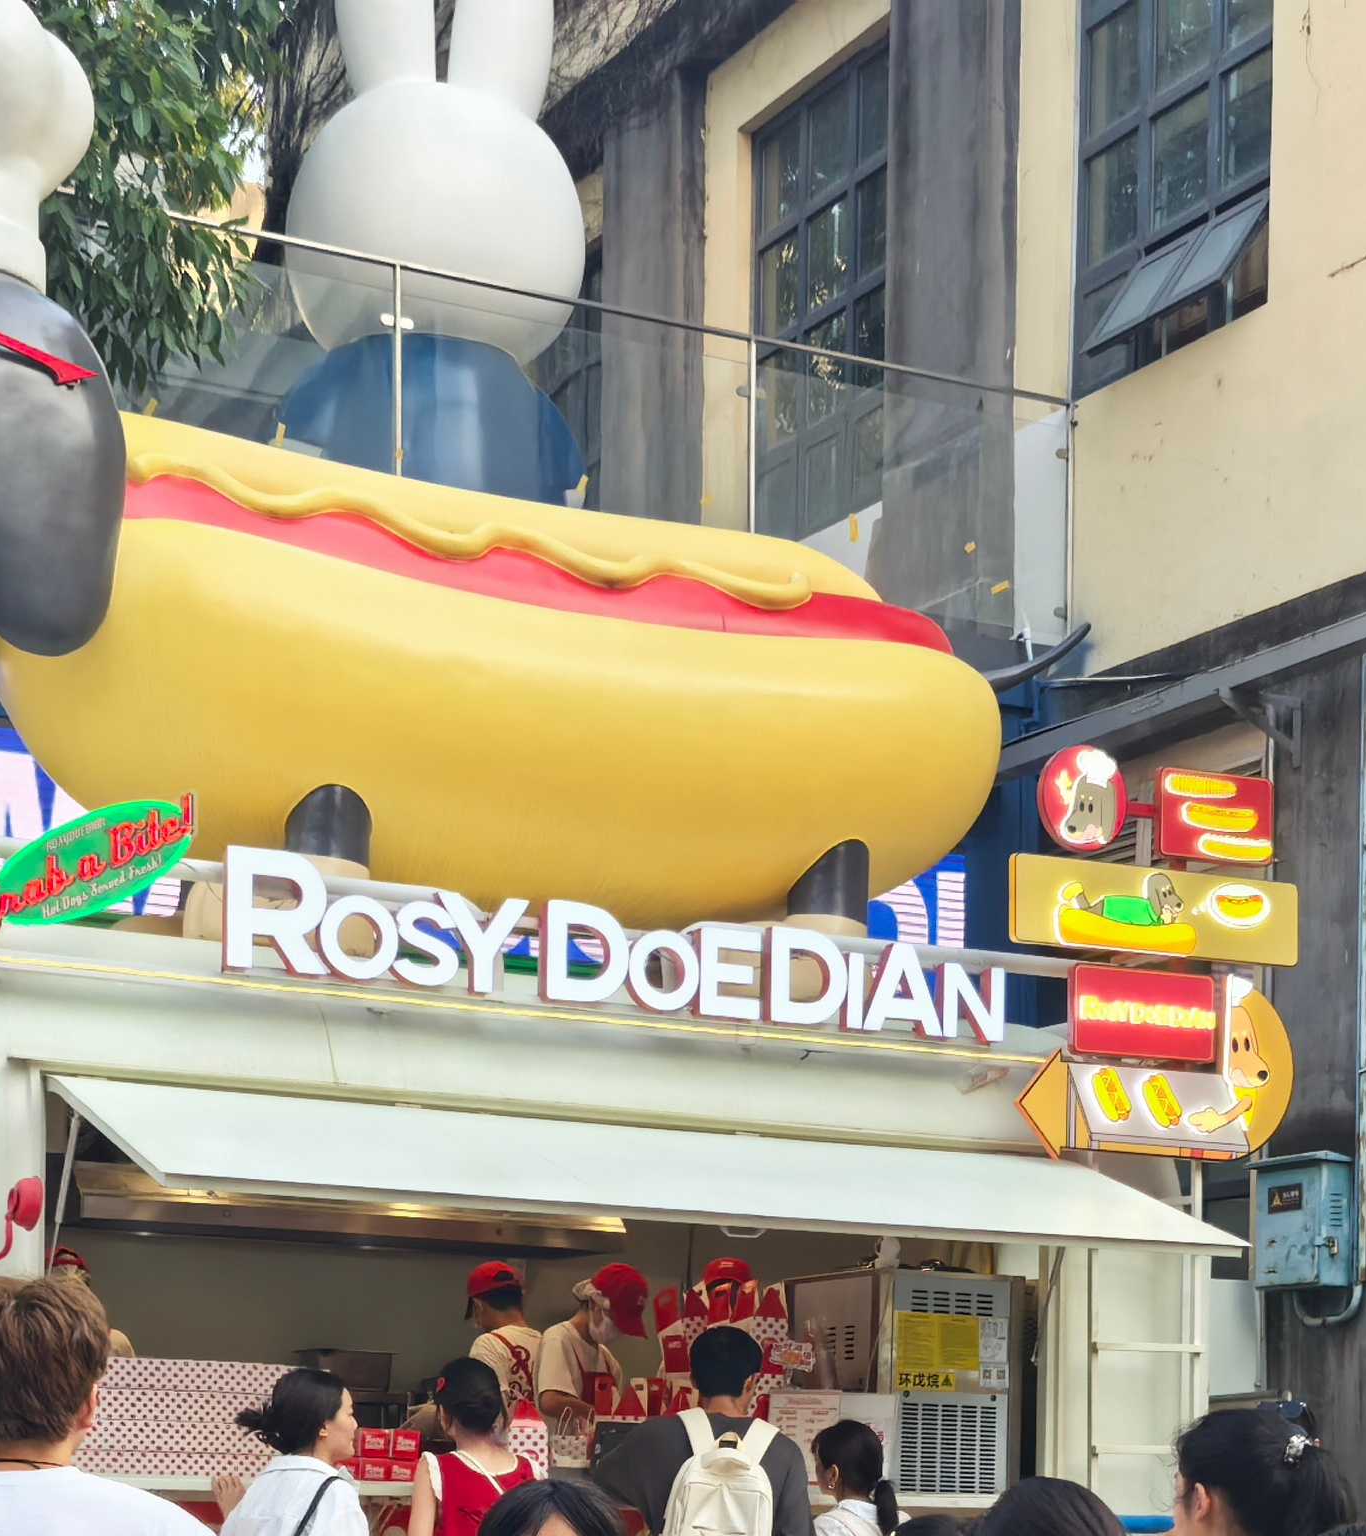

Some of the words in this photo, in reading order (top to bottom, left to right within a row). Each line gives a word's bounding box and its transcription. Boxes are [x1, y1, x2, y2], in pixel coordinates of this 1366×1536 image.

[77, 853, 107, 882] a
[108, 792, 194, 868] Bite!
[898, 1372, 940, 1388] 环戊烷
